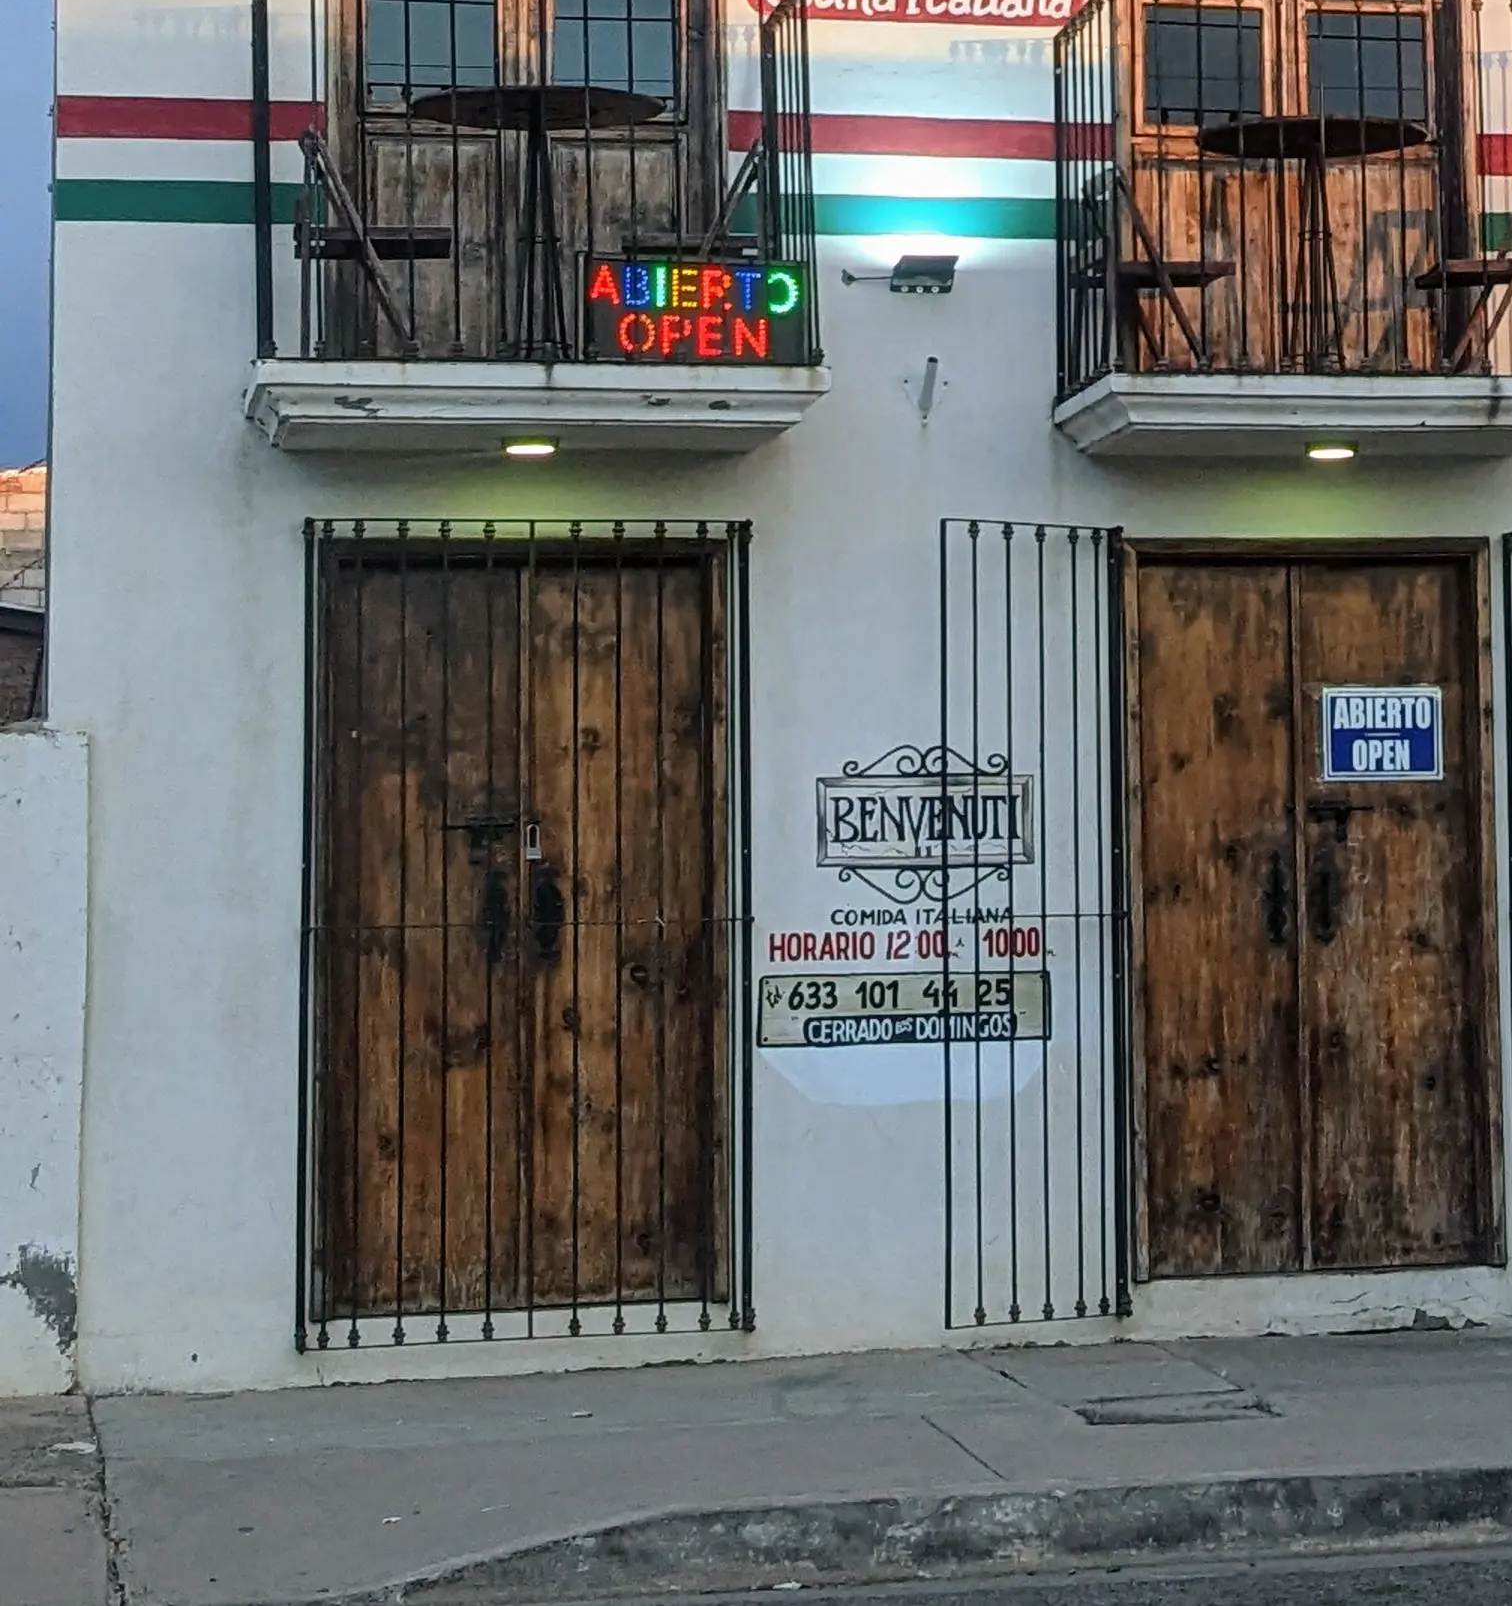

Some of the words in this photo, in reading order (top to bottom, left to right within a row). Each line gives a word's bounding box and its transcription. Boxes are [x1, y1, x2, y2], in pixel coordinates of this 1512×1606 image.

[618, 313, 769, 359] OPEN
[1333, 696, 1432, 730] ABIERTO
[1352, 739, 1411, 772] OPEN
[829, 794, 1021, 843] BENVENUTI
[831, 908, 908, 926] COMIDA
[915, 907, 1012, 926] ITALIANA
[768, 930, 876, 962] HORARIO
[788, 980, 838, 1011] 633
[855, 979, 899, 1009] 101
[977, 979, 1011, 1006] 25
[807, 1017, 892, 1044] CERRADO
